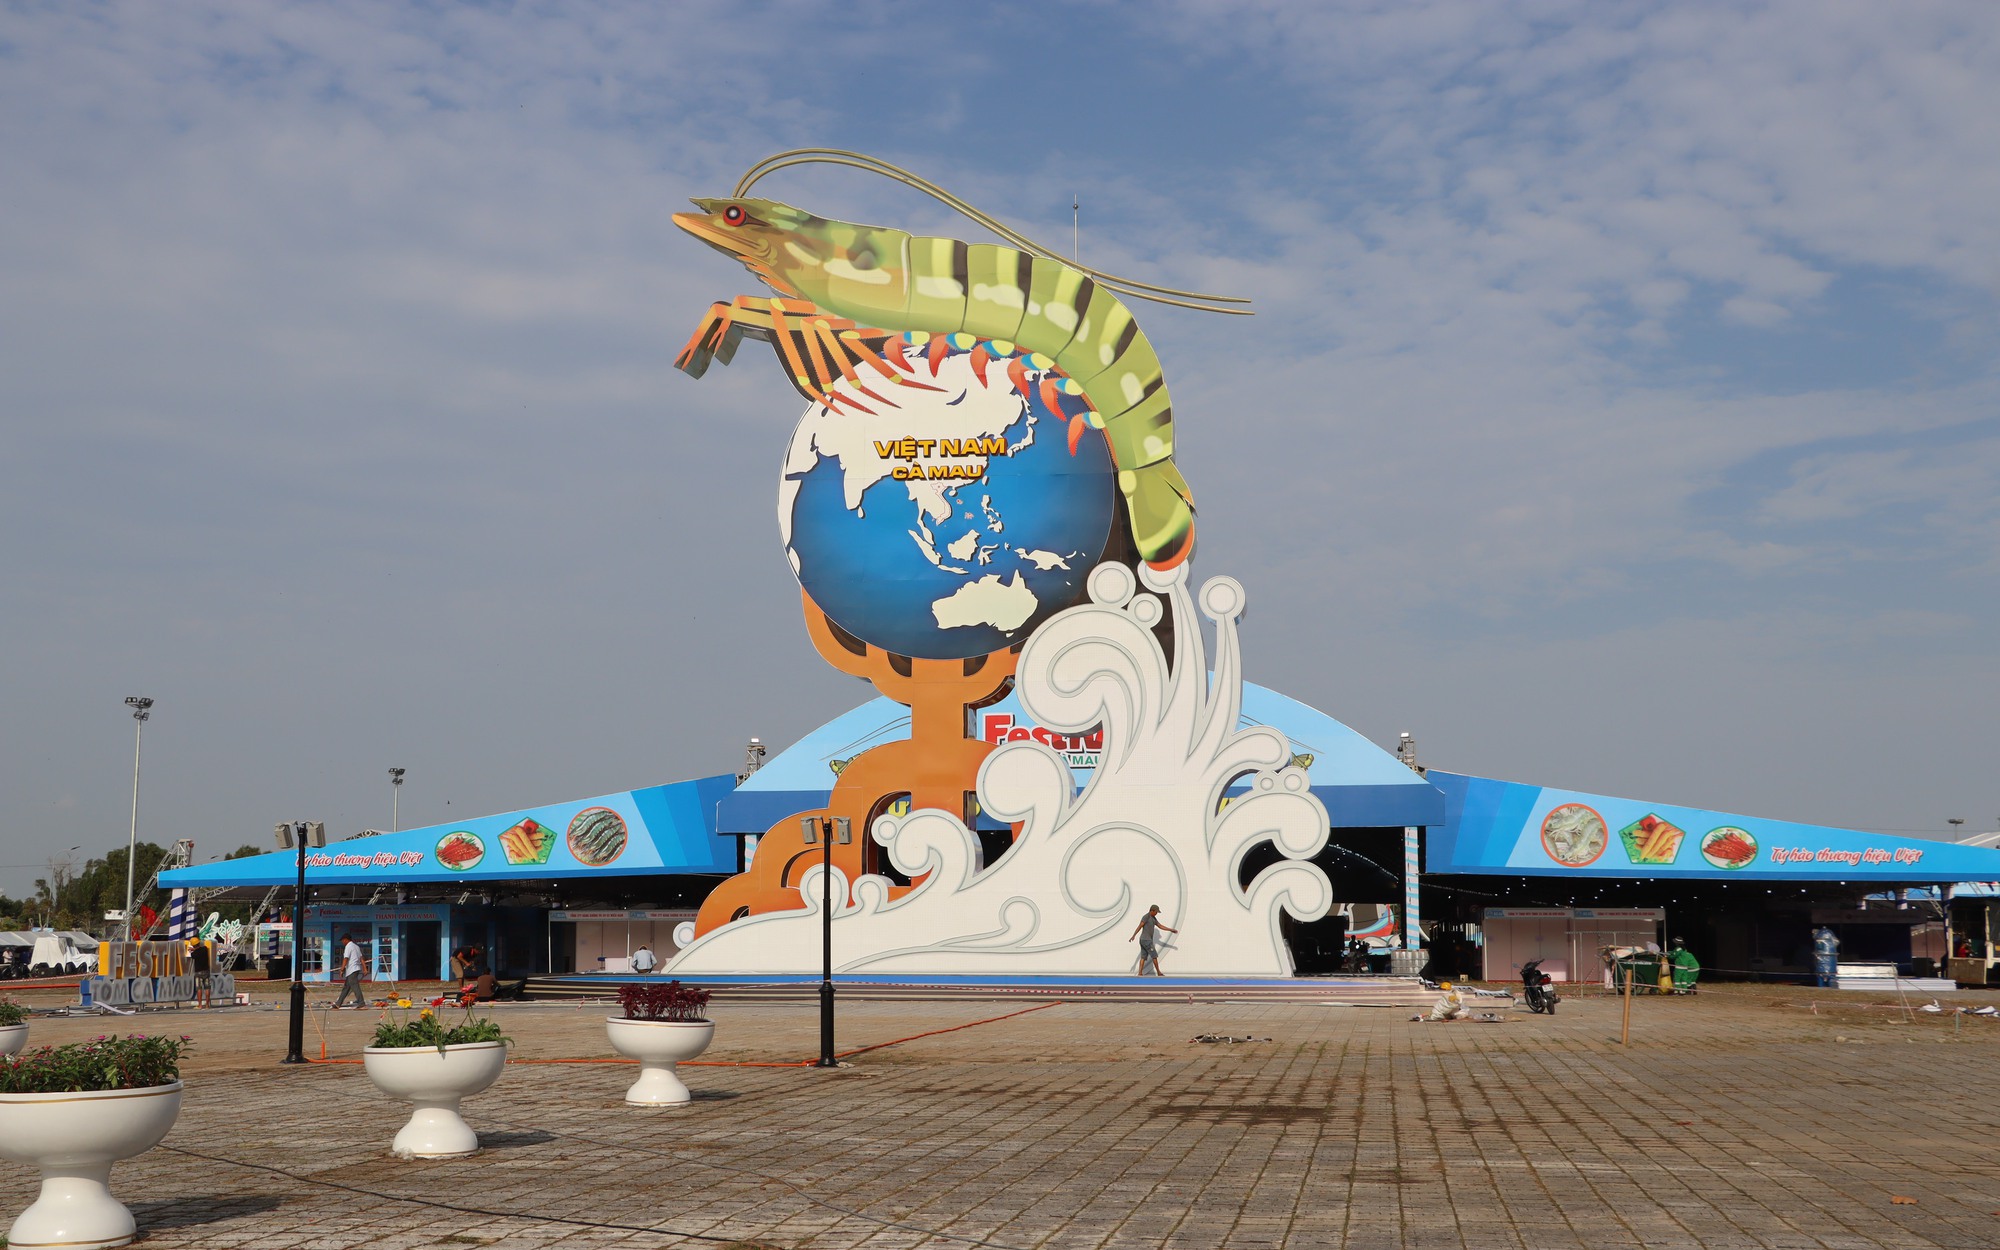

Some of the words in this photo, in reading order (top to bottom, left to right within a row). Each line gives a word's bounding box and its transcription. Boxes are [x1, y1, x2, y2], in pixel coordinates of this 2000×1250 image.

[873, 435, 936, 462] VIỆT
[940, 437, 1007, 458] NAM
[892, 461, 927, 481] CÀ
[928, 465, 984, 480] MAU
[983, 713, 1103, 750] Festiv
[311, 852, 333, 867] hào
[334, 852, 373, 869] thương
[374, 851, 398, 867] hiệu
[400, 851, 424, 867] Việt
[1771, 846, 1789, 864] Tự
[1789, 848, 1814, 862] hào
[1816, 847, 1862, 866] thương
[1862, 848, 1892, 865] hiệu
[1894, 848, 1924, 865] Việt
[108, 940, 223, 979] FESTIVL
[157, 978, 194, 1001] MAU
